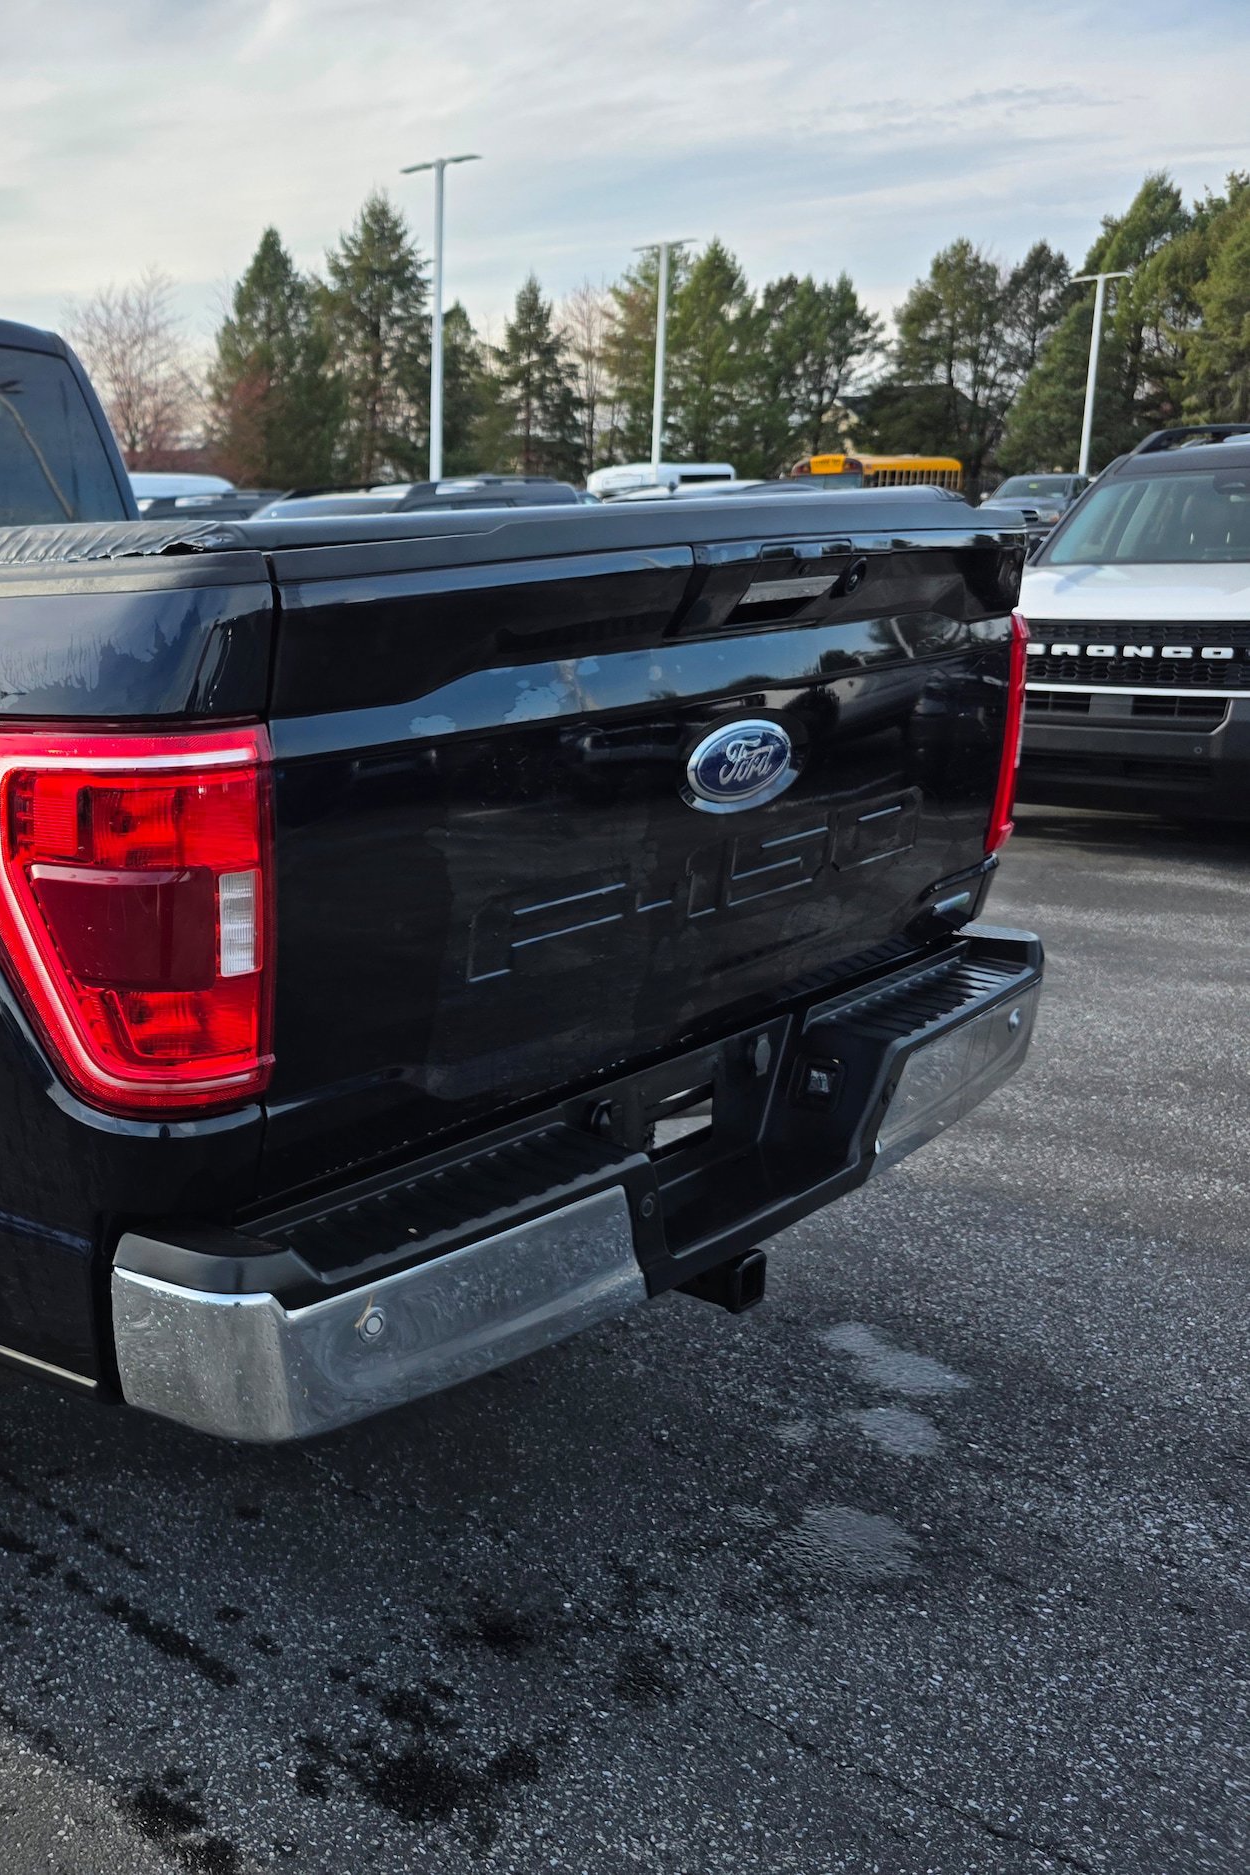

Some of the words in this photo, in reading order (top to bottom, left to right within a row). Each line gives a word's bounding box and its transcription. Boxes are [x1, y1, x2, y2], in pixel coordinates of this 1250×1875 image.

[1026, 643, 1234, 660] BRONCO
[718, 738, 774, 785] Ford
[466, 785, 923, 983] F-150
